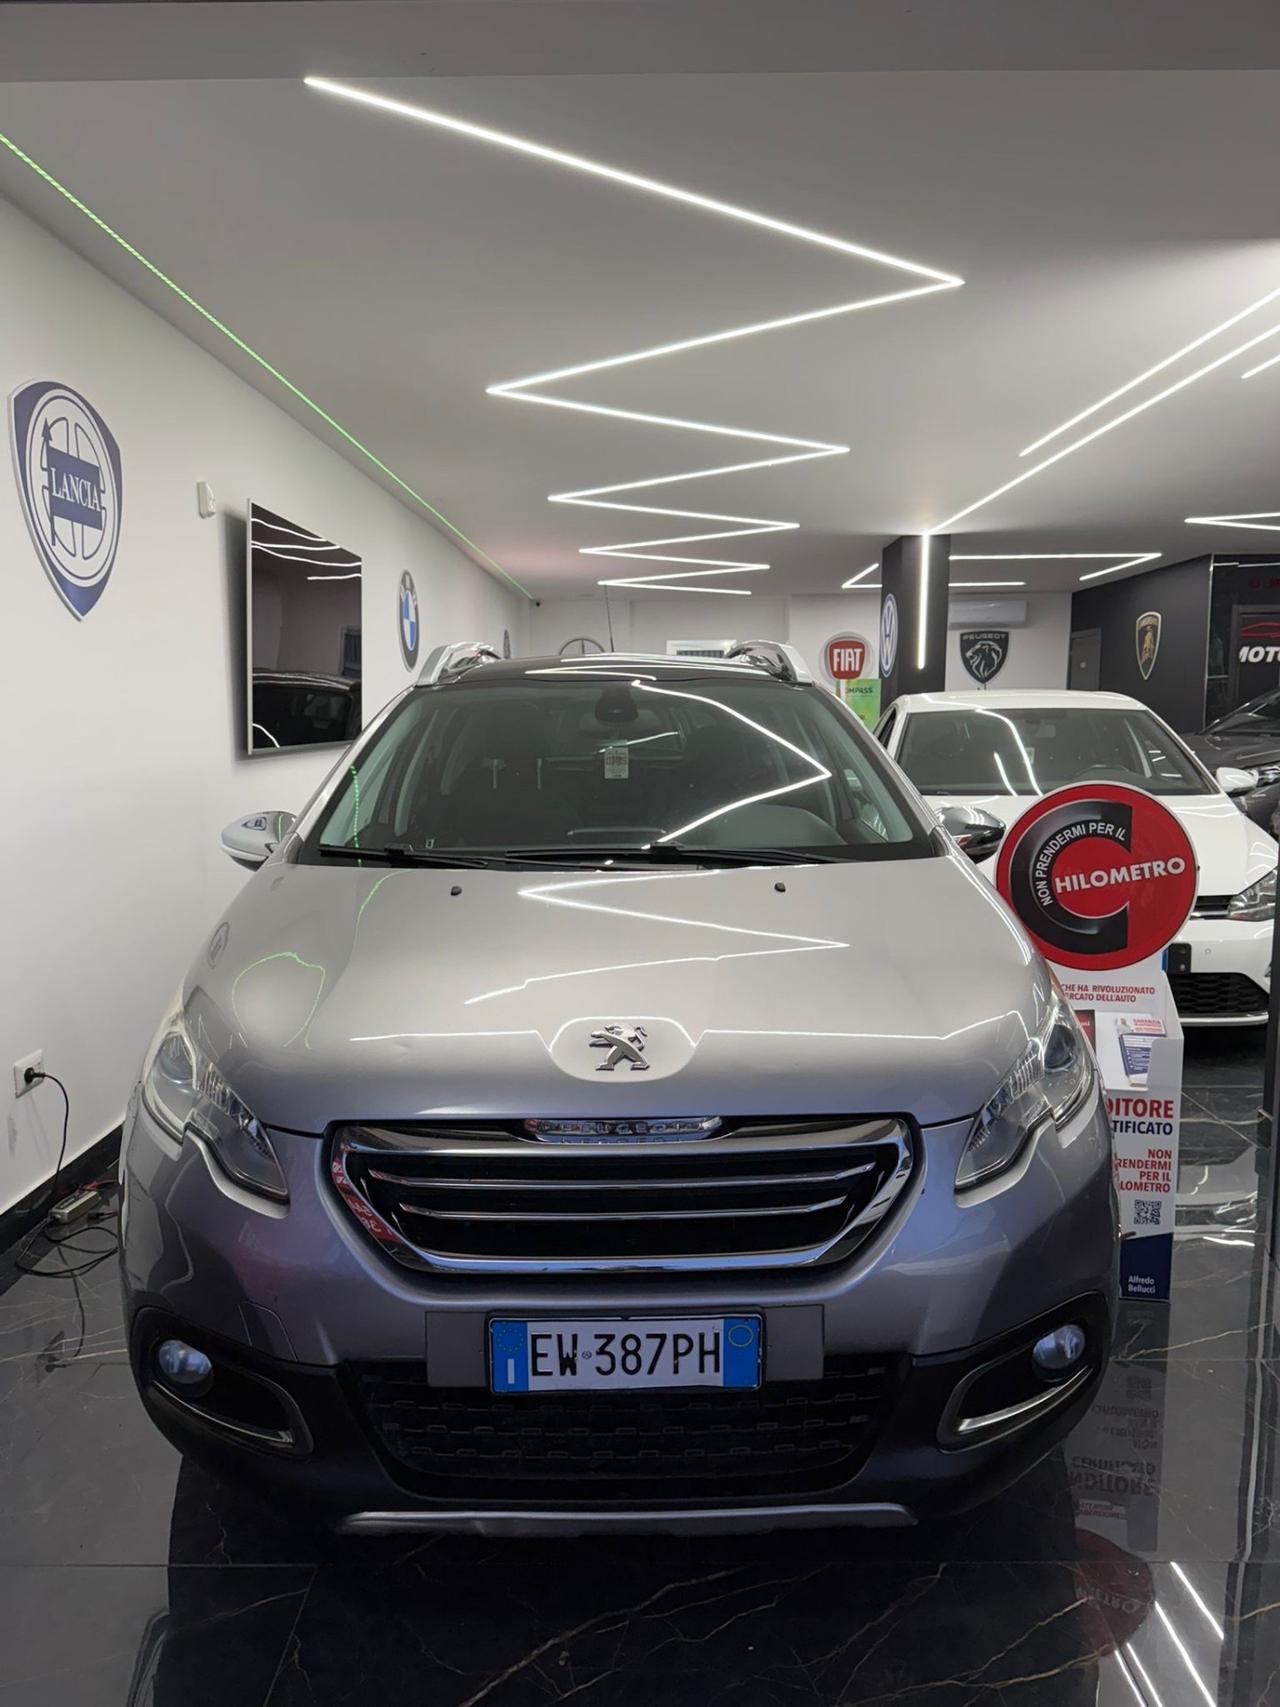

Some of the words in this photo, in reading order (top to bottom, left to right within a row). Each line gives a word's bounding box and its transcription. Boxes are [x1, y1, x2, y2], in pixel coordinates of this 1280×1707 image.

[50, 467, 101, 511] LANCIA
[833, 648, 863, 672] FIAT
[1089, 822, 1114, 835] PER
[1115, 827, 1126, 841] IL
[1035, 825, 1087, 878] PRENDERMI
[1054, 857, 1186, 893] HILOMETRO
[1035, 881, 1053, 906] NON
[1078, 984, 1089, 992] HA
[1092, 986, 1156, 995] RIVOLUZIONATO
[1096, 994, 1137, 1003] DELL'AUTO
[1148, 1149, 1172, 1160] NON
[1140, 1171, 1160, 1181] PER
[1162, 1172, 1172, 1182] IL
[1128, 1275, 1155, 1285] Alfredo
[1128, 1284, 1156, 1294] Bellucci
[531, 1334, 578, 1377] EW
[594, 1332, 721, 1377] 387PH
